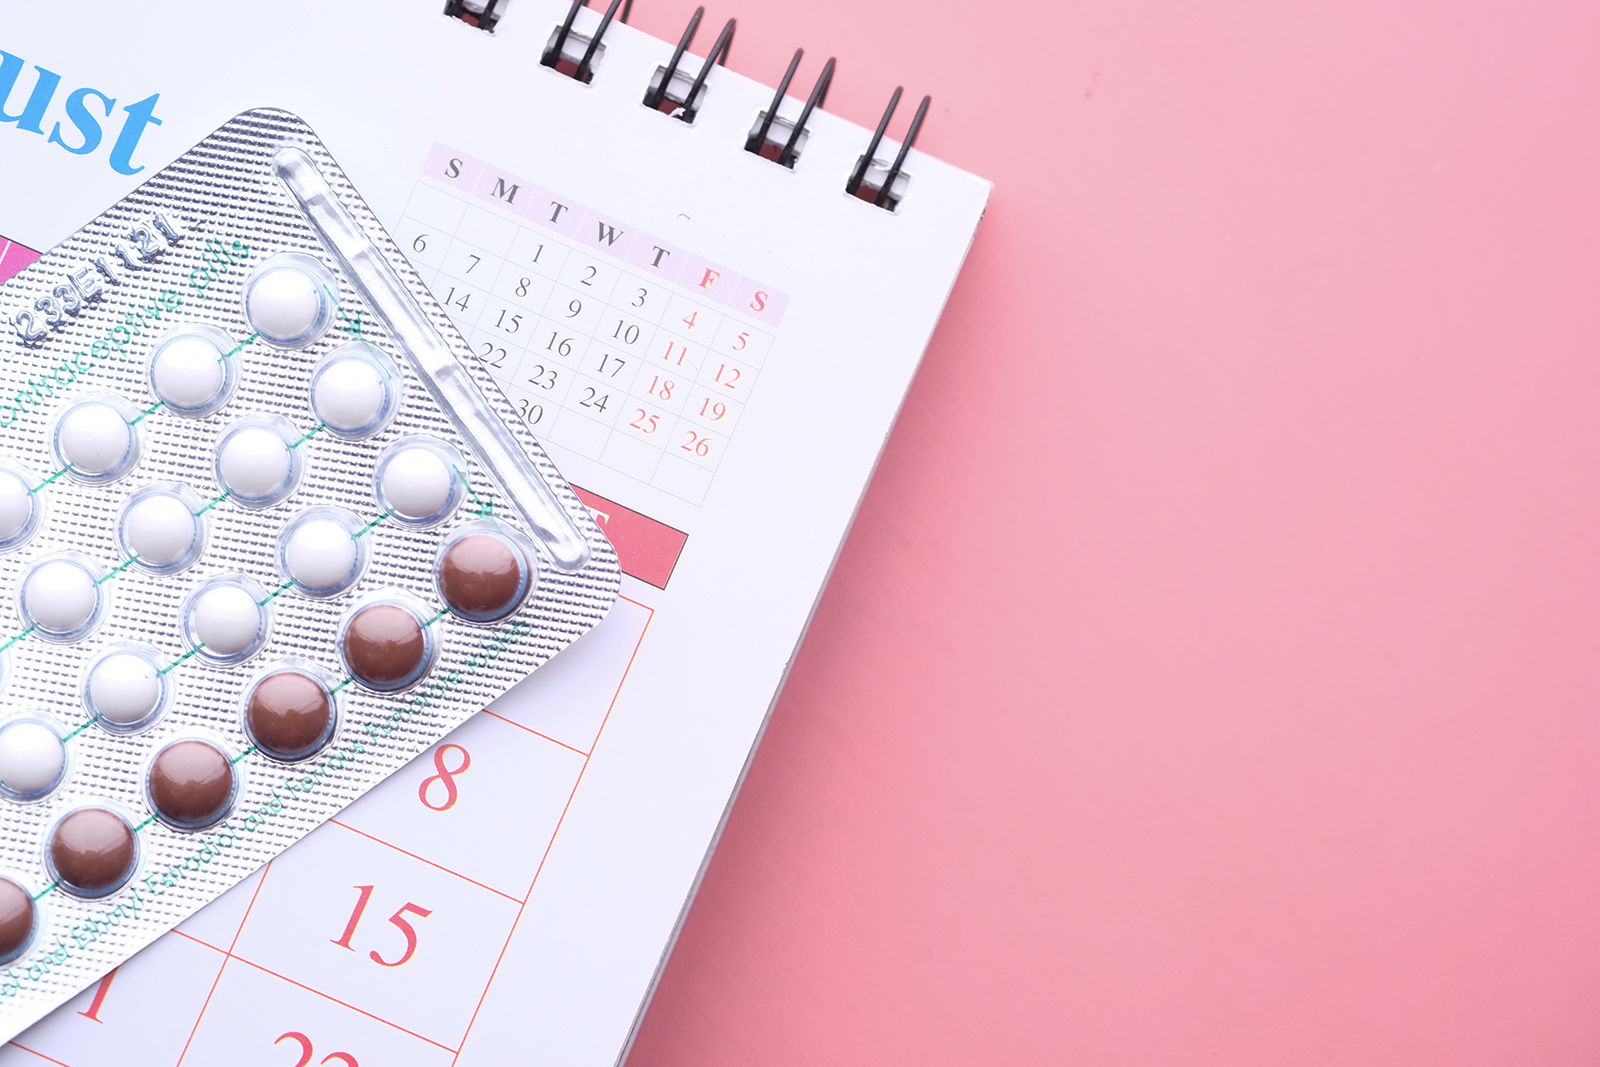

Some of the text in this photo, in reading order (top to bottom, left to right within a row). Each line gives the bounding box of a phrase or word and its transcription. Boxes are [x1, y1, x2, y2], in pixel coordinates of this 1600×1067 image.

[0, 49, 163, 176] ust
[187, 237, 250, 301] pills
[444, 158, 768, 312] S M T W T F S
[412, 234, 741, 390] 6 7 8 9 10 11 12
[443, 287, 726, 421] 14 15 16 17 18 19
[532, 244, 751, 352] 1 2 3 4 5
[478, 342, 709, 457] 22 23 24 25 26
[518, 398, 544, 425] 30
[418, 743, 471, 812] 8
[27, 937, 70, 981] and
[143, 821, 239, 897] Estradiol
[243, 788, 286, 832] and
[285, 739, 366, 801] Ferrous
[330, 885, 433, 967] 15
